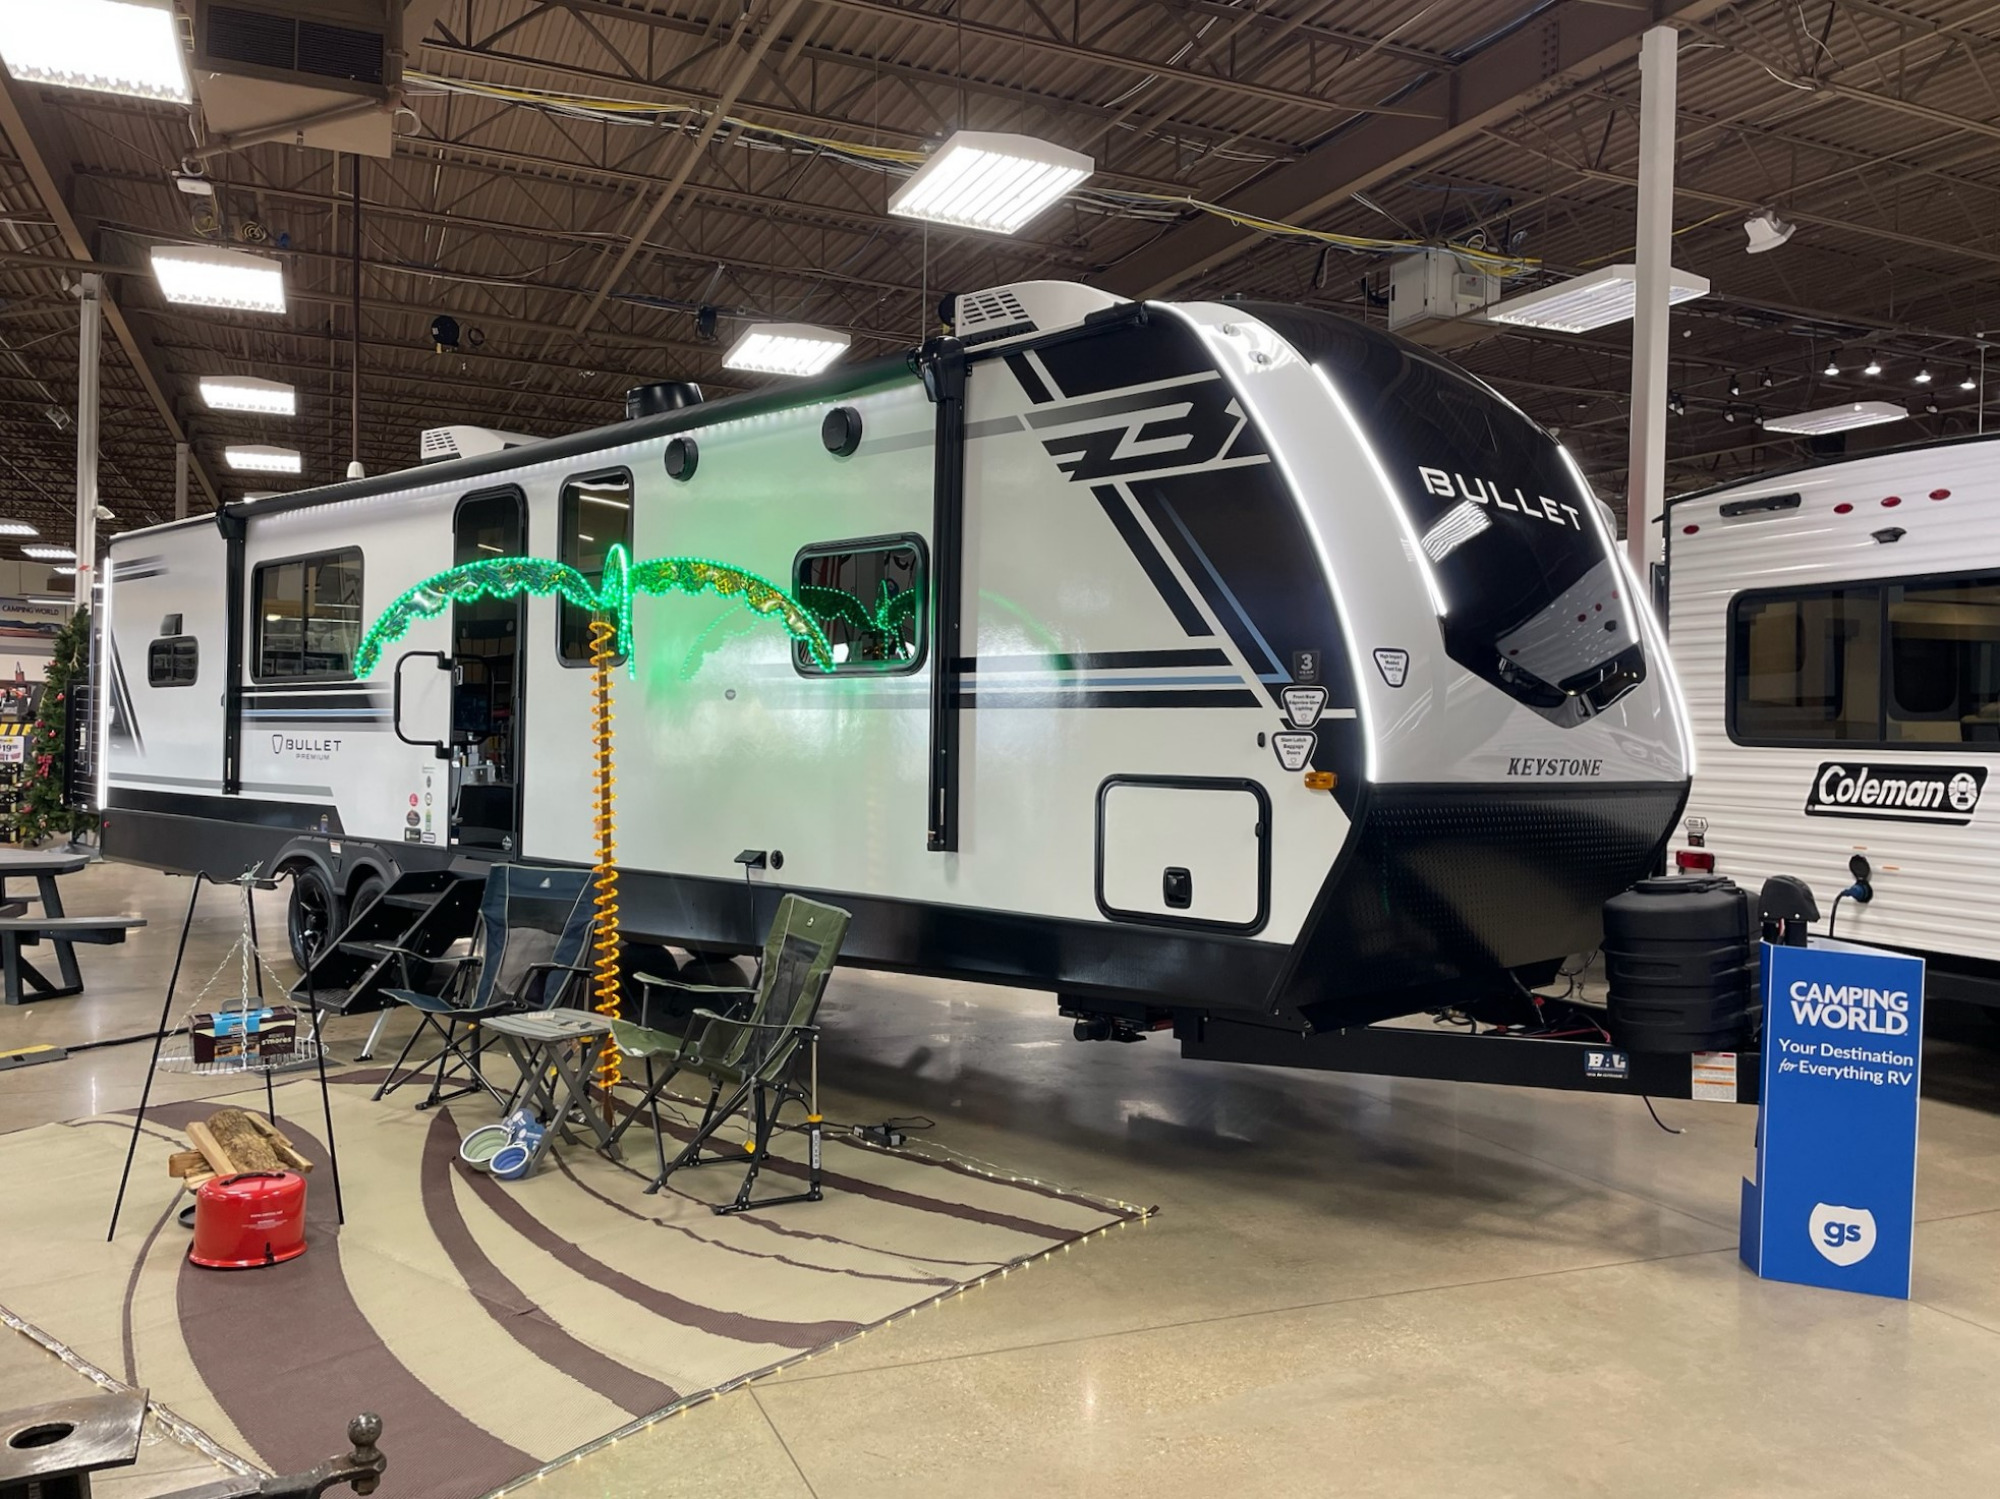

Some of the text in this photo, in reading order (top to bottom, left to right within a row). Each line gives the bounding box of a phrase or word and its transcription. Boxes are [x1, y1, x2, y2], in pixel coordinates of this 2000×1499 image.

[1417, 465, 1581, 531] BULLET
[2, 604, 60, 616] CAMPING WORLD
[1300, 653, 1313, 670] 3
[285, 738, 342, 751] BULLET
[1507, 757, 1603, 777] KEYSTONE
[1819, 765, 1945, 808] Coleman
[1789, 981, 1909, 1012] CAMPING
[1791, 1000, 1909, 1036] WORLD
[1778, 1038, 1914, 1067] Your Destination
[1777, 1058, 1913, 1086] for Everything RV
[1823, 1220, 1862, 1247] gs
